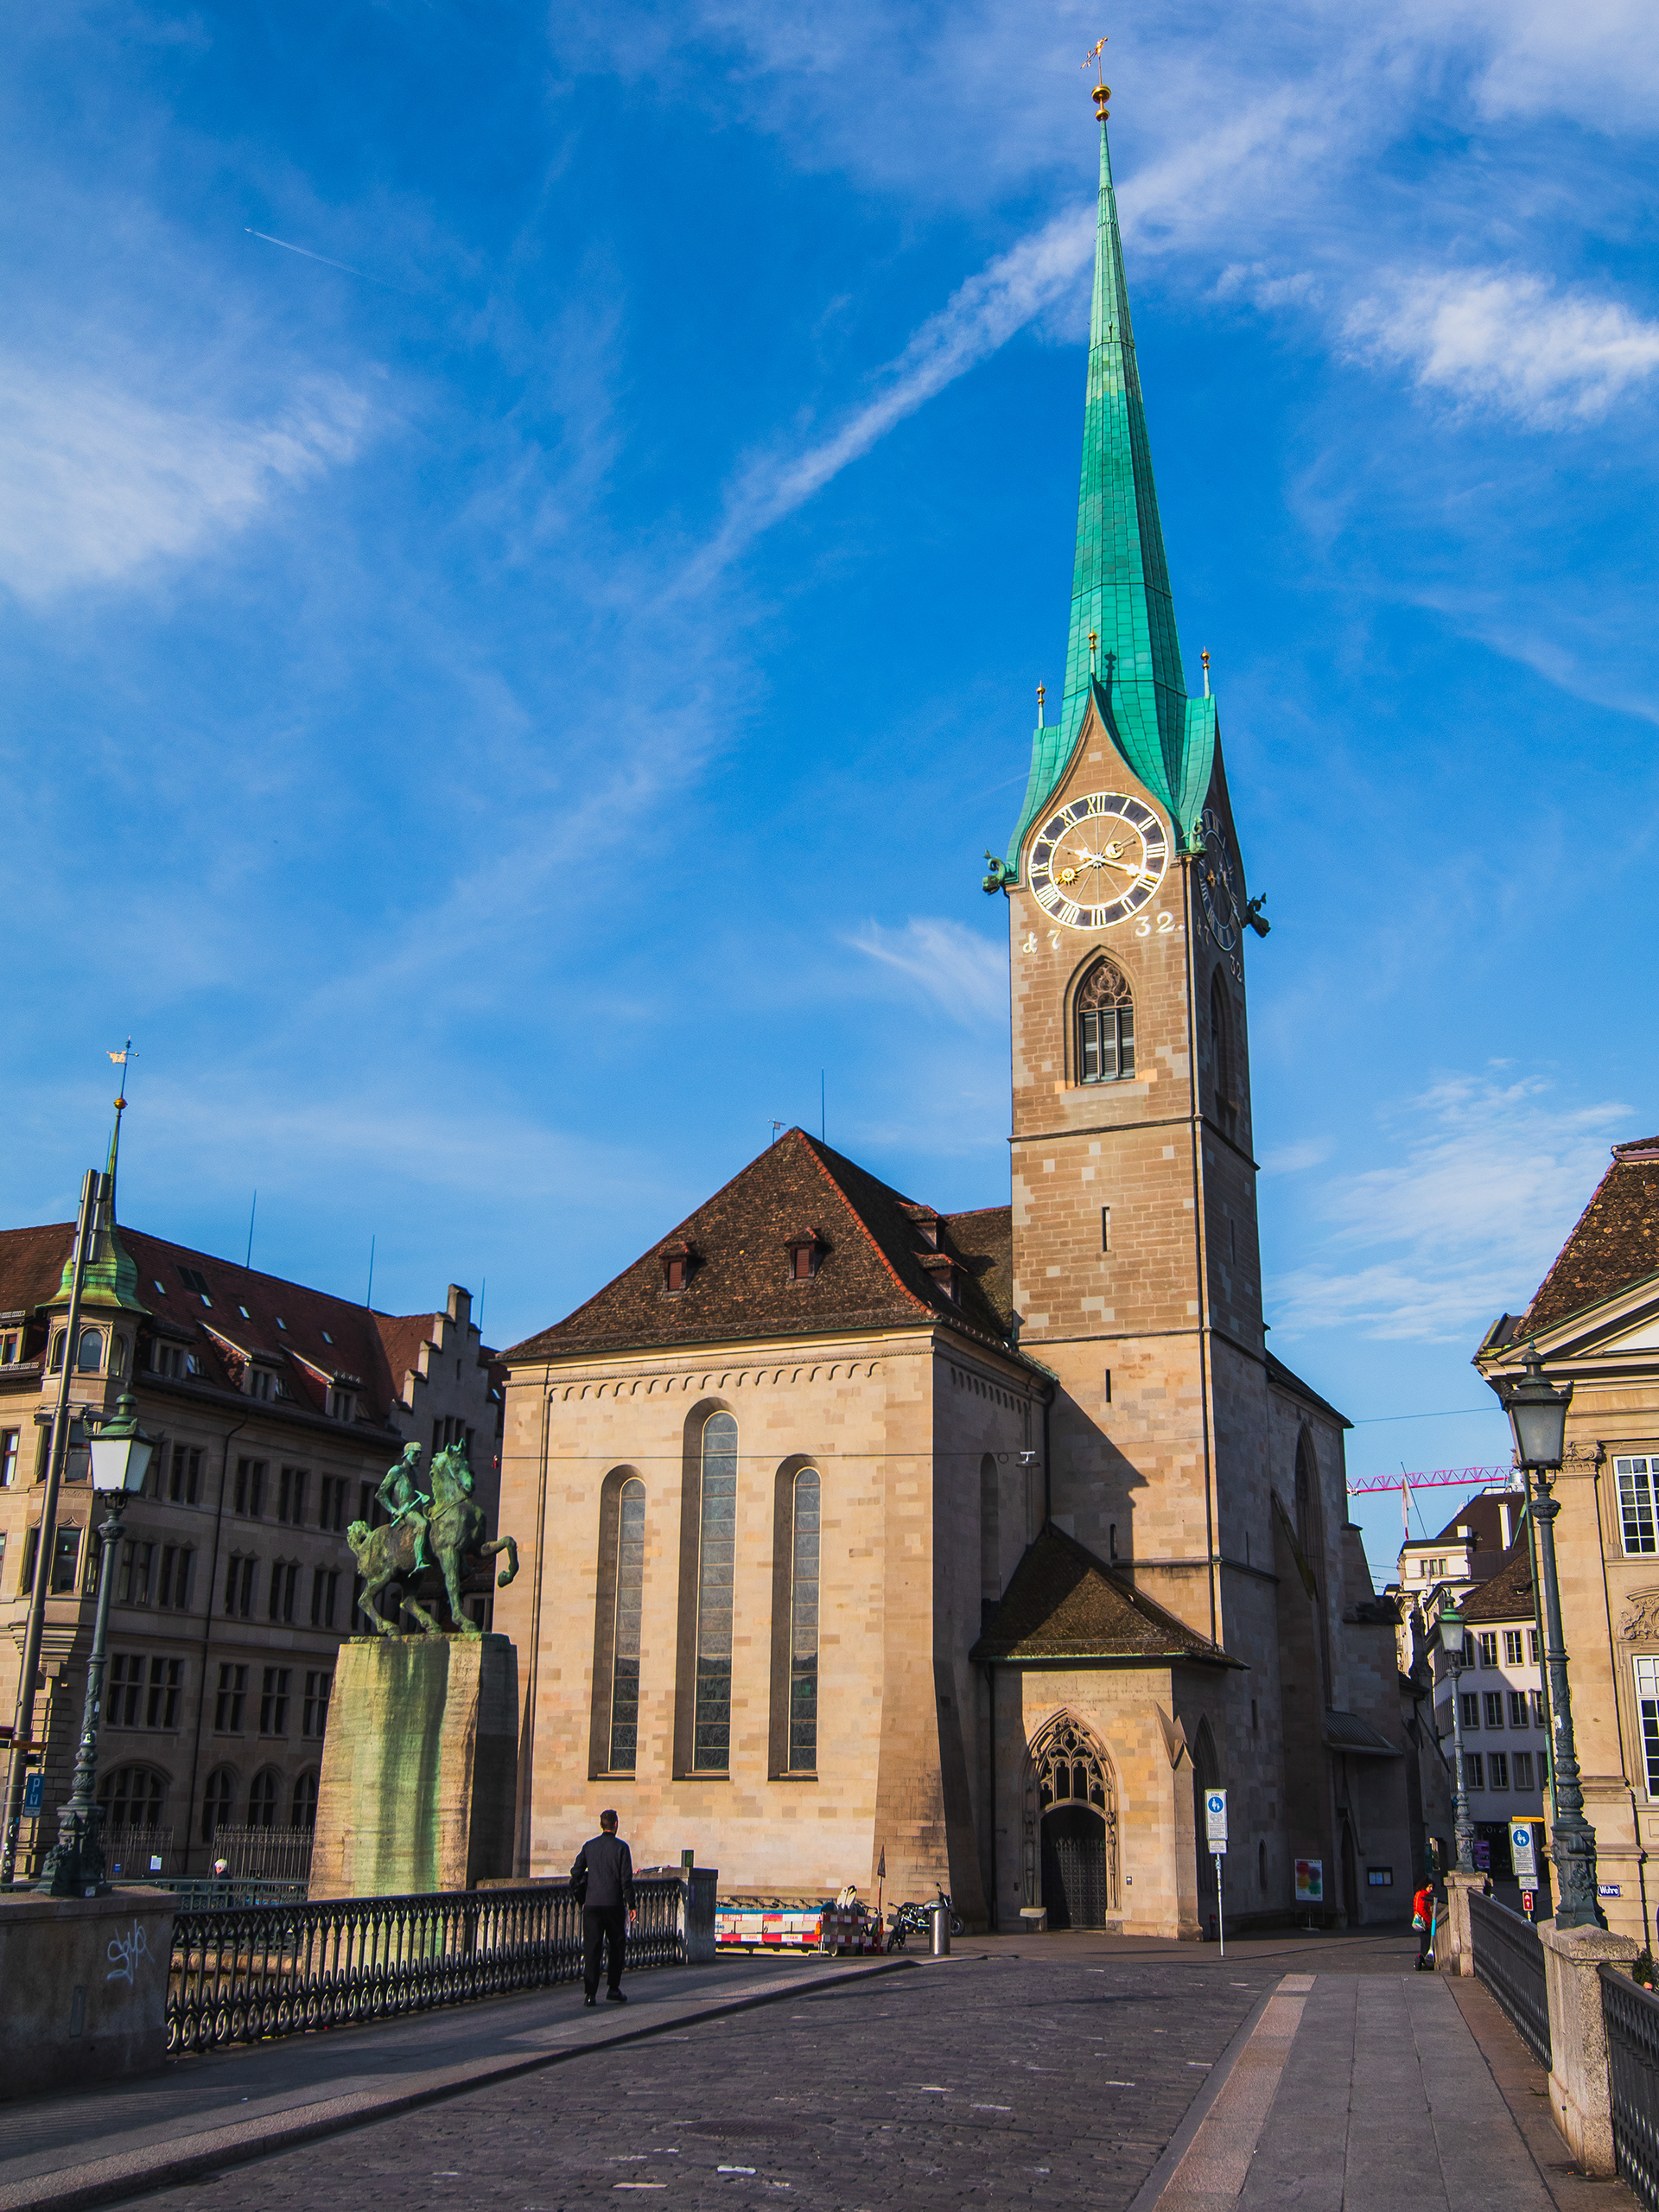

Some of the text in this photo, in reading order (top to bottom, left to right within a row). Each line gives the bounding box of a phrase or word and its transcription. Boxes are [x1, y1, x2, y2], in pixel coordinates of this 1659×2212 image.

[1087, 795, 1106, 814] XII
[1120, 798, 1131, 815] I
[1058, 807, 1077, 827] XI
[1138, 815, 1156, 832] II
[1038, 833, 1056, 847] X
[1147, 842, 1165, 858] III
[1031, 861, 1049, 878] IX
[32, 1778, 40, 1793] P
[1599, 1885, 1618, 1895] Wuhre
